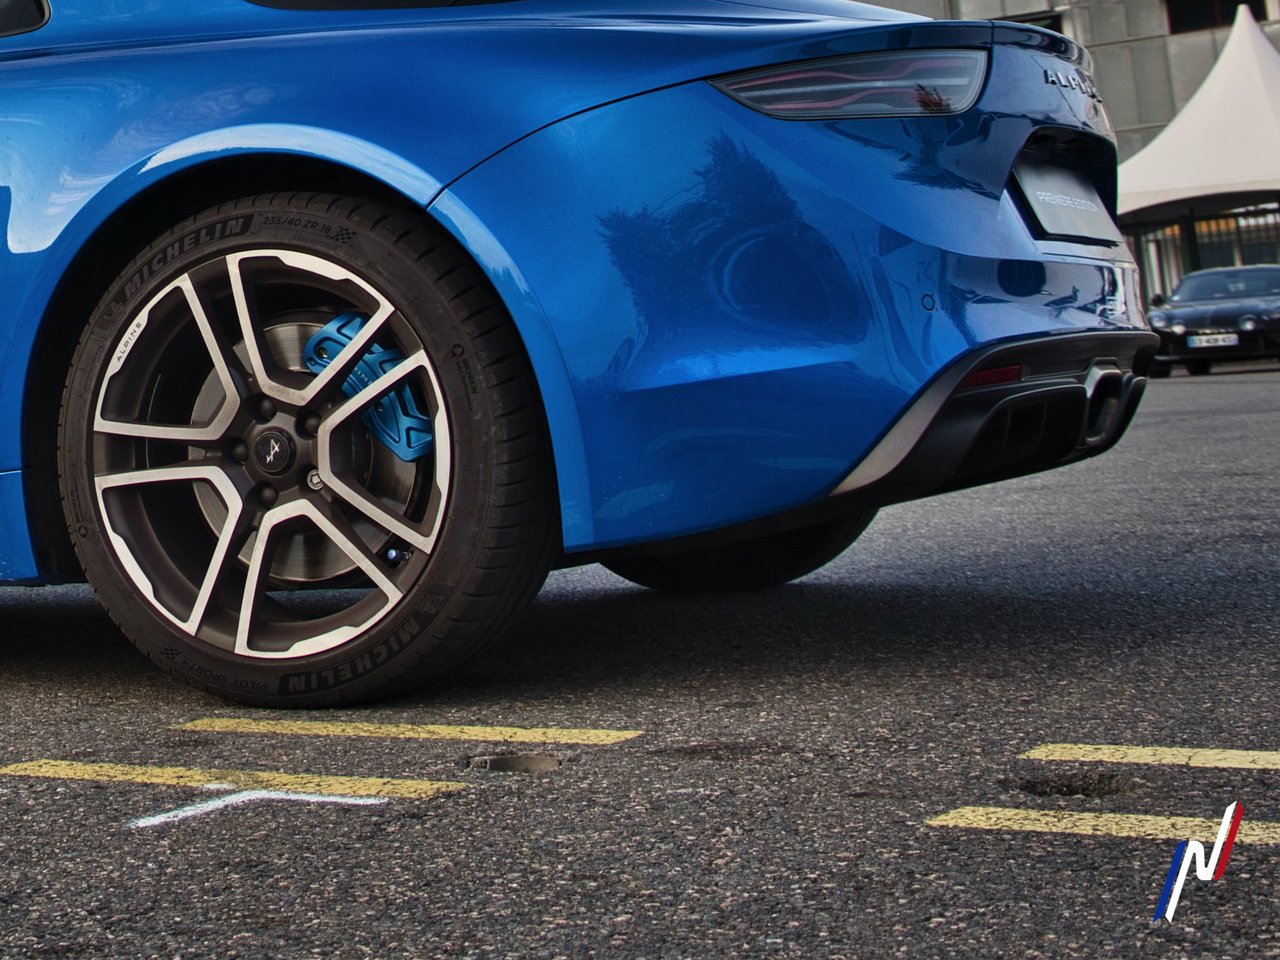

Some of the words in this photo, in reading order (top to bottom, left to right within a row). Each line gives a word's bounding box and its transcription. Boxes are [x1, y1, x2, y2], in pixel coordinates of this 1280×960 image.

[262, 216, 303, 227] 235/40
[303, 219, 319, 230] ZR
[320, 223, 332, 234] 18
[124, 218, 244, 299] MICHELIN
[117, 322, 141, 362] ALPINE
[288, 618, 420, 692] MICHELIN
[189, 663, 228, 683] SPORT
[232, 678, 267, 691] PILOT
